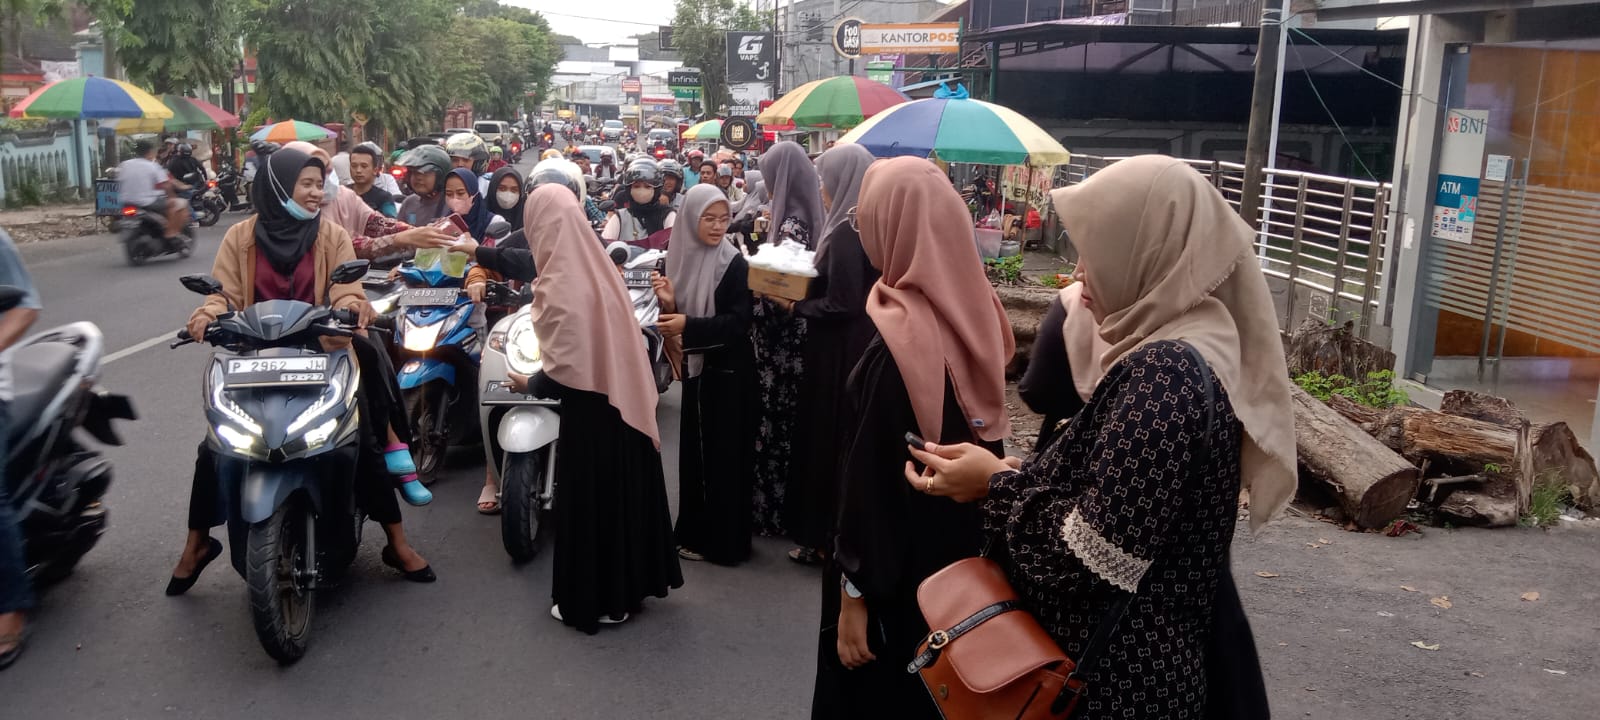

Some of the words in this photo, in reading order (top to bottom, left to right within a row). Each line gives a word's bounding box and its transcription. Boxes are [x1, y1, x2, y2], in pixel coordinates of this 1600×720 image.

[1460, 118, 1484, 134] BNI
[1440, 181, 1461, 195] ATM
[1459, 194, 1476, 213] 24
[233, 362, 241, 372] P
[252, 361, 287, 372] 2962
[491, 383, 498, 392] P
